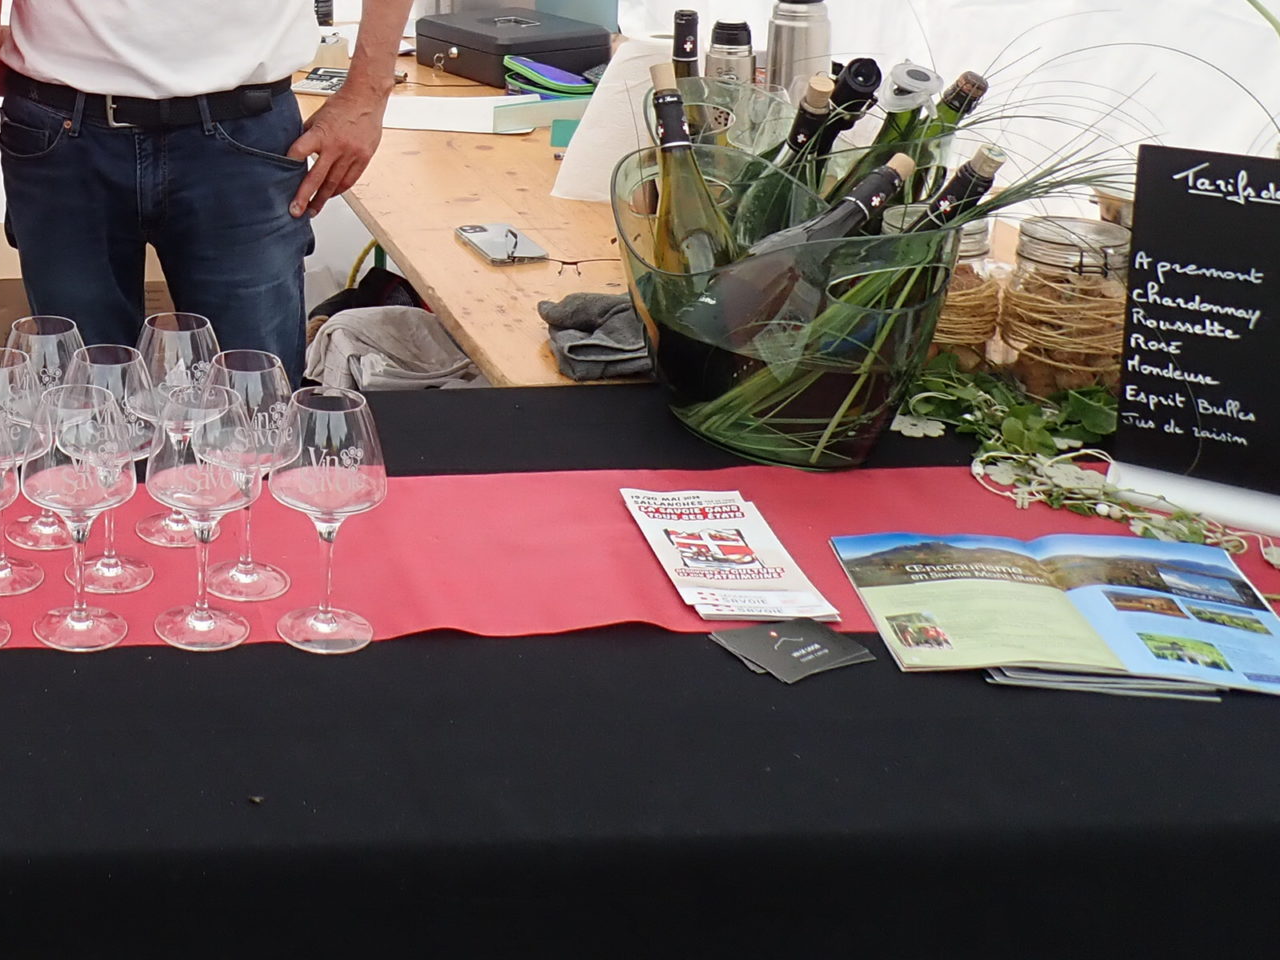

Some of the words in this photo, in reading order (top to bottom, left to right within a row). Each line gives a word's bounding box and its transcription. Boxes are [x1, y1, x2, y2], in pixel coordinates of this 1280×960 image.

[1131, 307, 1241, 339] Roussette
[1125, 385, 1186, 411] Esprit
[1196, 398, 1257, 422] Bulles
[234, 424, 294, 448] Savoie
[1121, 412, 1156, 429] Jus
[1163, 419, 1185, 434] de
[1191, 426, 1249, 447] raisin
[307, 446, 339, 474] Vin
[647, 512, 679, 520] TOUS
[659, 506, 701, 514] SAVOIE
[704, 505, 739, 513] DANS
[706, 572, 782, 580] PATRIMOINE
[910, 573, 928, 581] en
[931, 570, 972, 580] Savoie
[973, 570, 1009, 580] Mont
